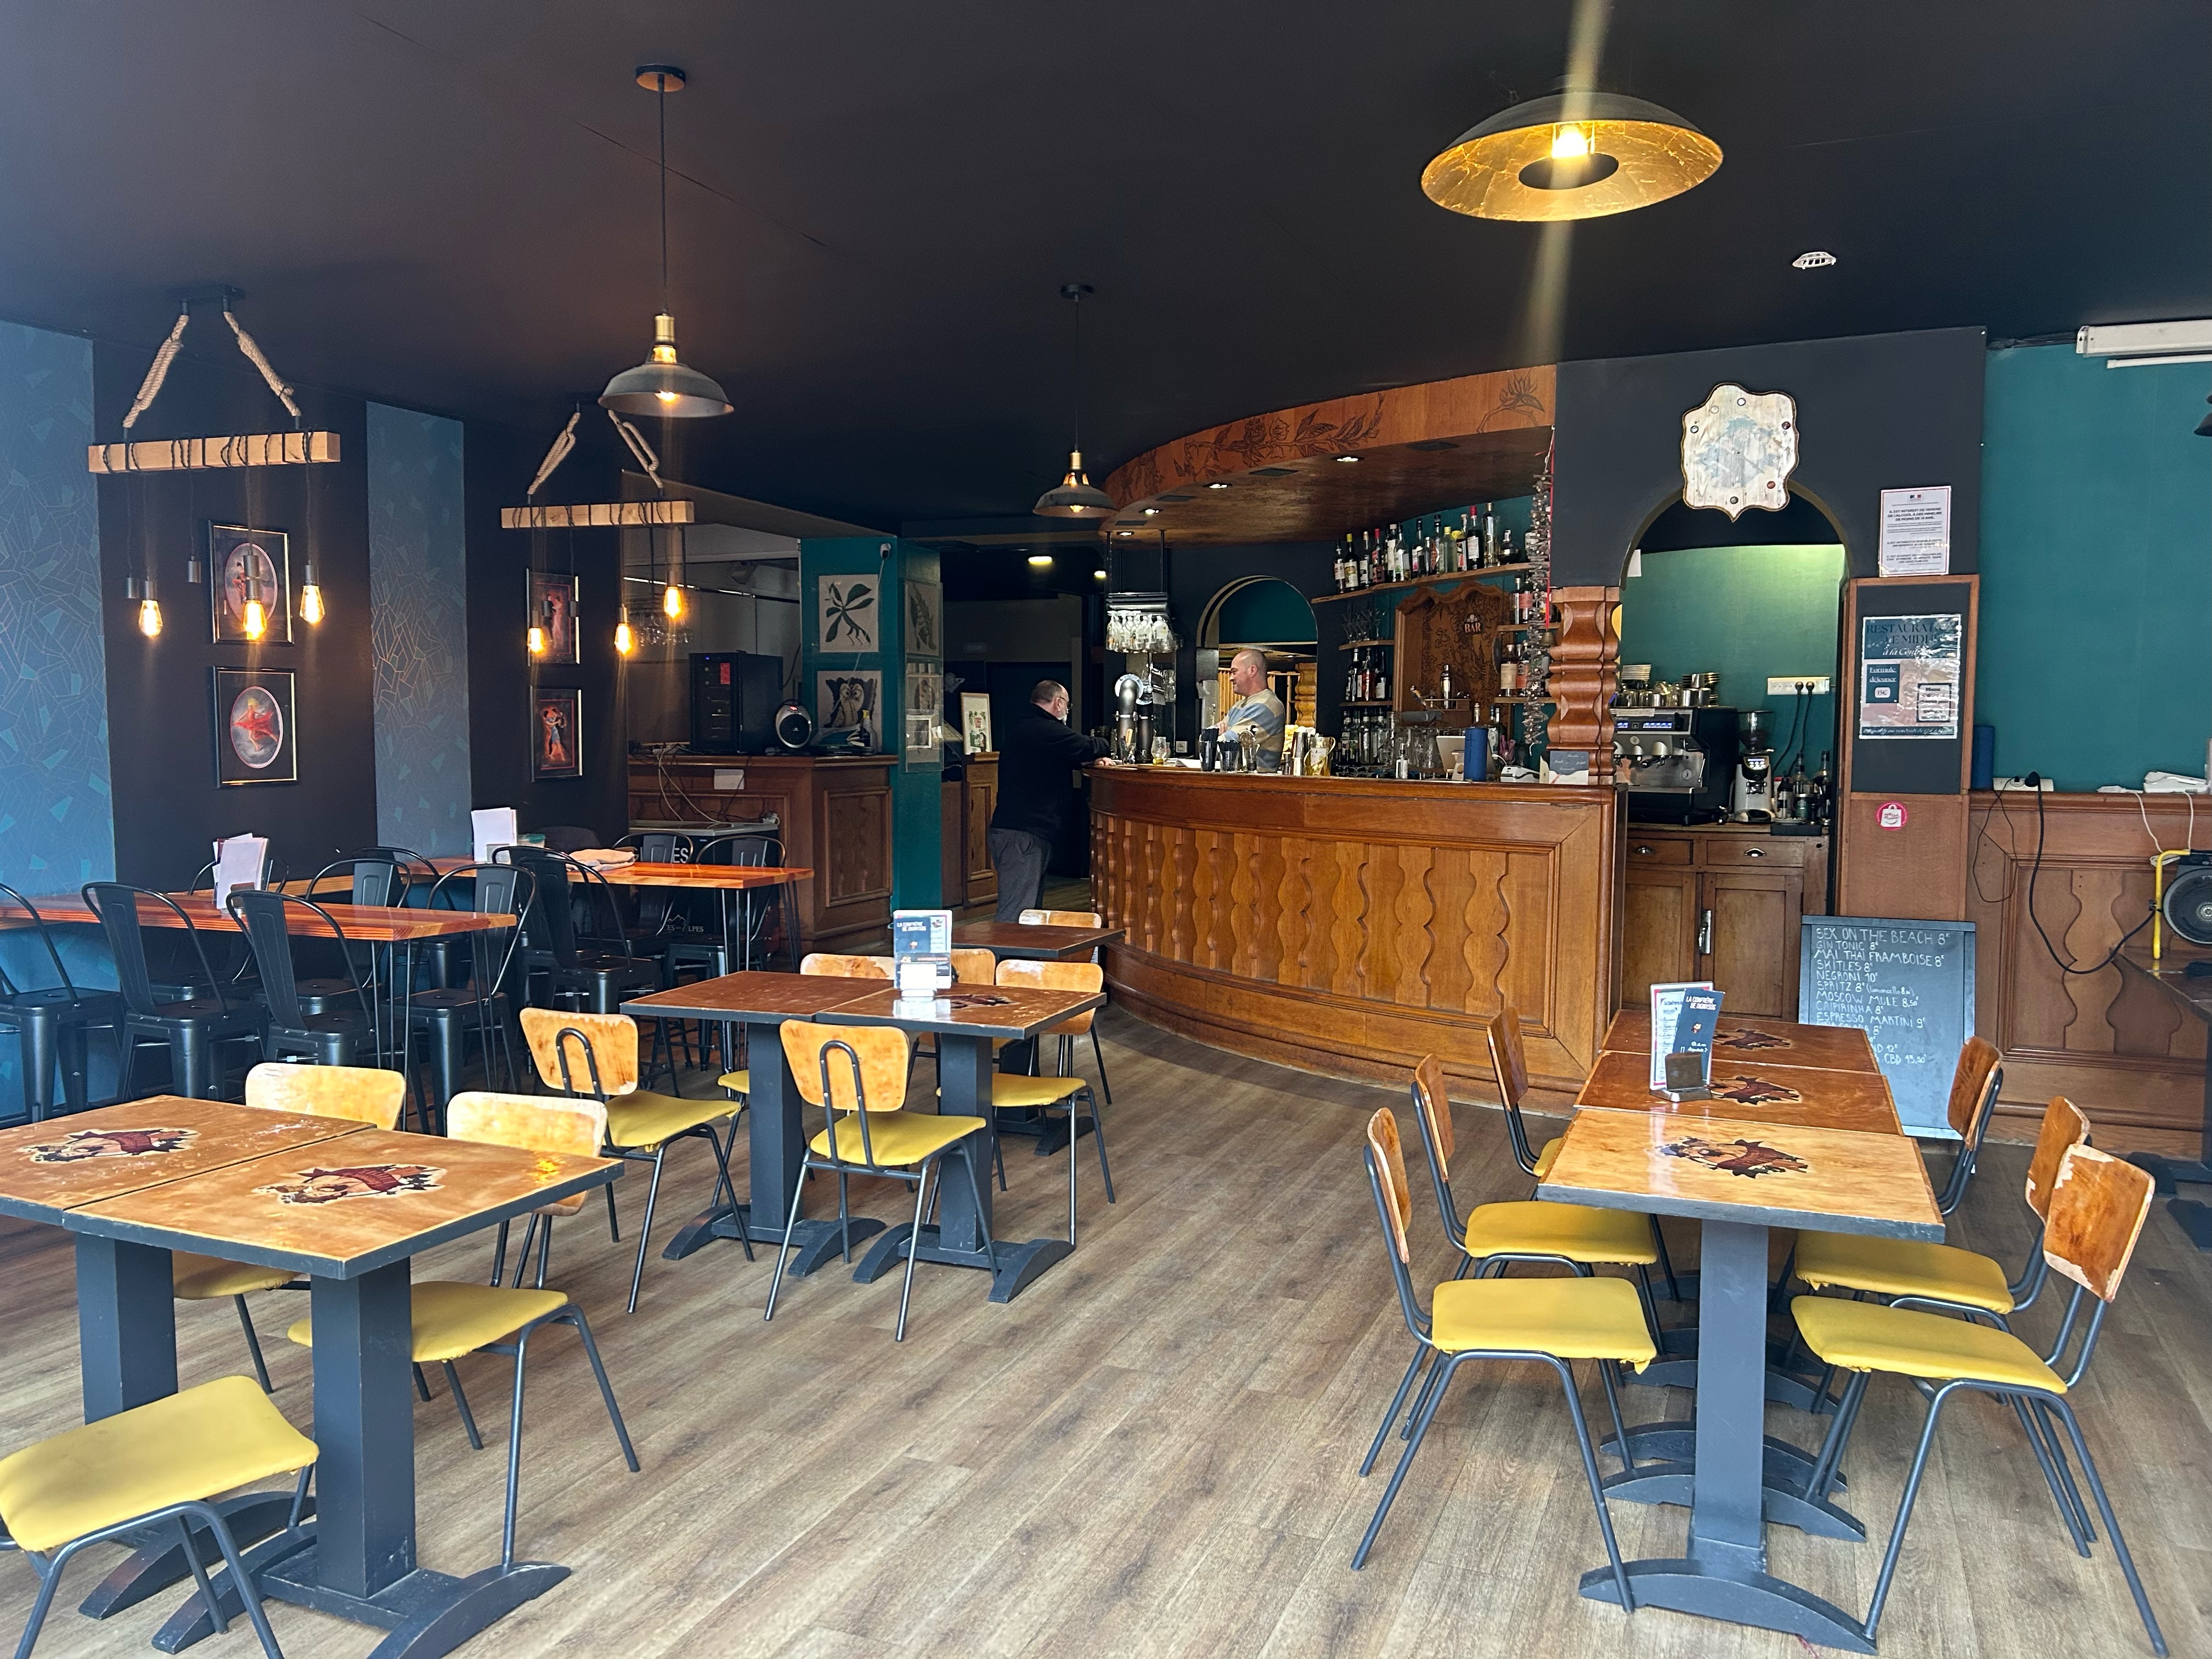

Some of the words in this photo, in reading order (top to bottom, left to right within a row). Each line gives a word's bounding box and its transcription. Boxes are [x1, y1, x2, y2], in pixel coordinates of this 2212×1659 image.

[1465, 622, 1481, 633] BAR
[1816, 928, 1838, 940] SEX
[1842, 928, 1858, 941] ON
[1859, 929, 1887, 942] THE
[1891, 930, 1933, 944] BEACH
[1816, 940, 1833, 949] GIN
[1835, 940, 1865, 951] TONIC
[1814, 949, 1838, 960] MAI
[1843, 950, 1865, 961] THAI
[1869, 951, 1933, 966] FRAMBOISE
[1816, 960, 1862, 971] SKITLES
[1816, 970, 1861, 981] NEGRONI
[1817, 980, 1852, 991] SPRITZ
[1816, 990, 1864, 1004] MOSCOW
[1869, 995, 1899, 1007] MULE
[1816, 1000, 1873, 1014] CAIPIRINHA
[1816, 1012, 1864, 1023] ESPRESSO
[1870, 1015, 1913, 1028] MARTINI
[1884, 1053, 1901, 1065] CBD
